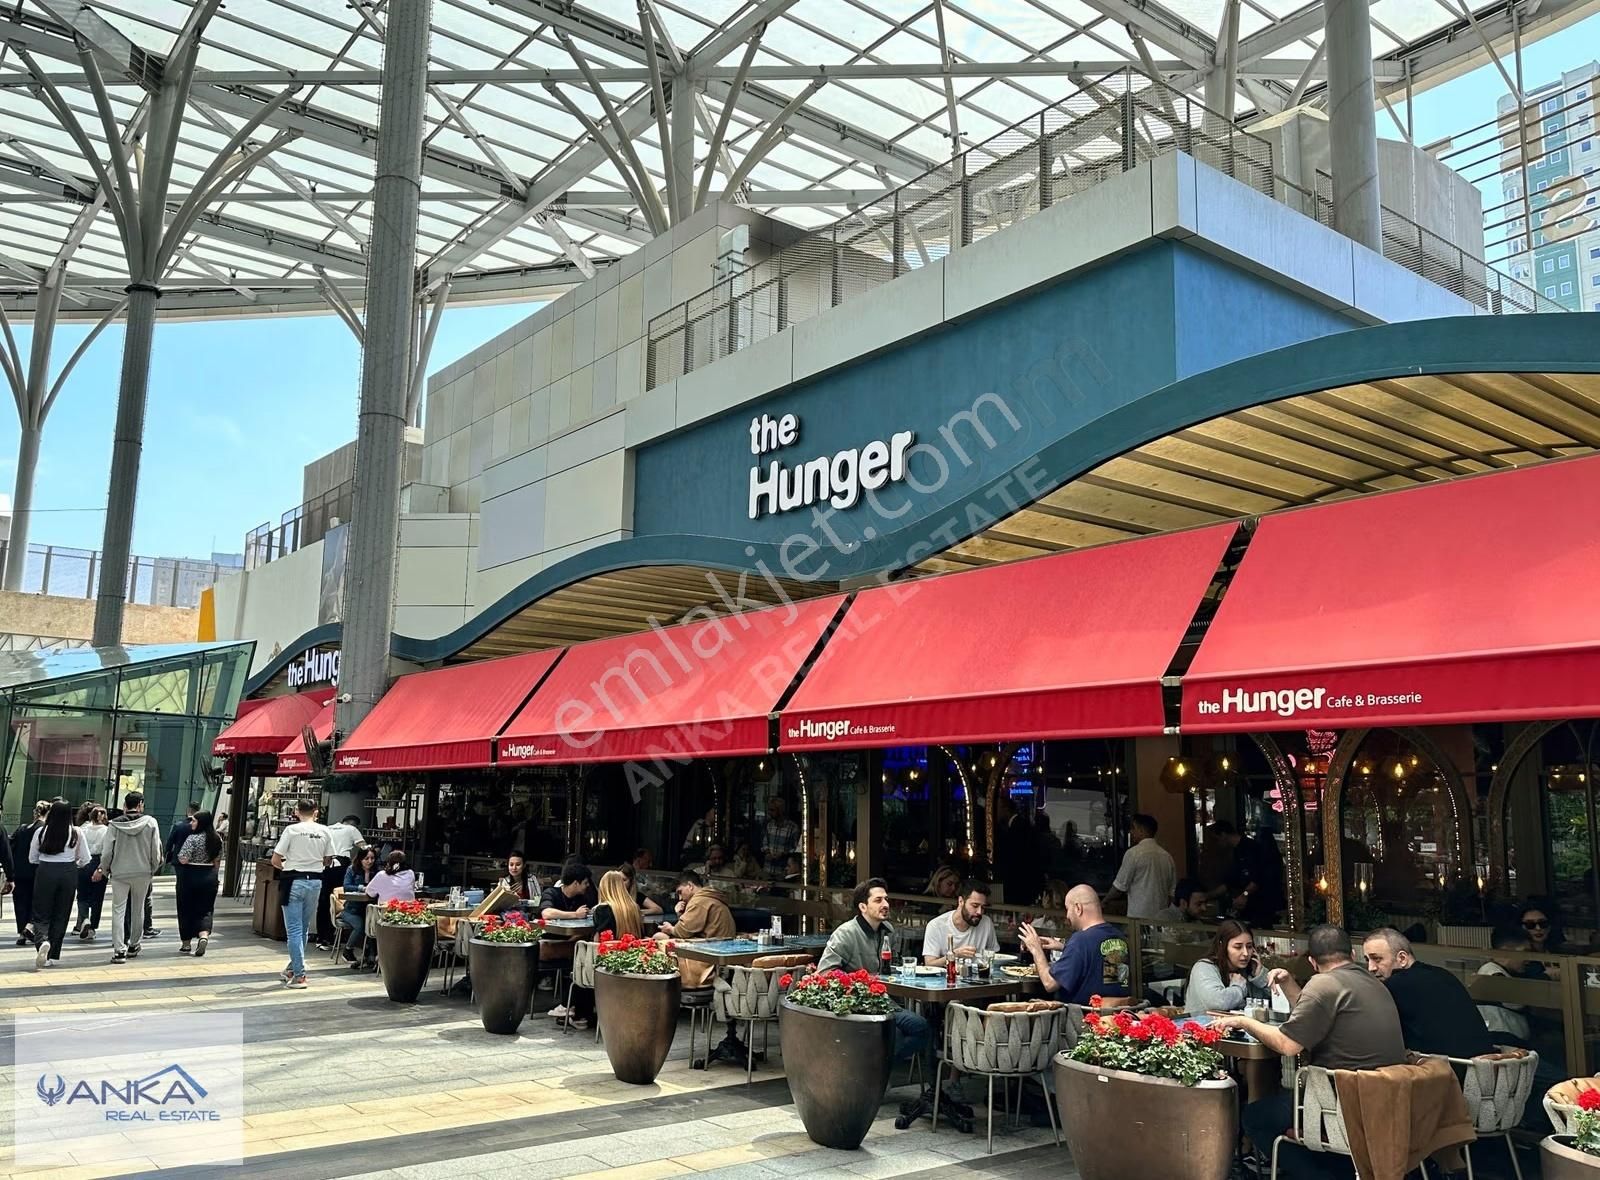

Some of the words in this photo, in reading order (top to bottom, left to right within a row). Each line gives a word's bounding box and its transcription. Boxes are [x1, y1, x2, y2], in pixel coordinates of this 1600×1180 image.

[749, 413, 798, 455] the
[748, 430, 914, 520] Hunger
[287, 662, 303, 687] the
[304, 647, 341, 687] Hung
[1198, 700, 1221, 715] the
[1222, 687, 1326, 717] Hunger
[1326, 696, 1353, 709] Cafe
[1355, 694, 1366, 707] &
[1367, 691, 1422, 706] Brasserie
[788, 728, 800, 738] the
[800, 719, 850, 740] Hunger
[849, 726, 863, 735] Cafe
[868, 724, 896, 734] Brasserie
[508, 743, 535, 759] Hunger
